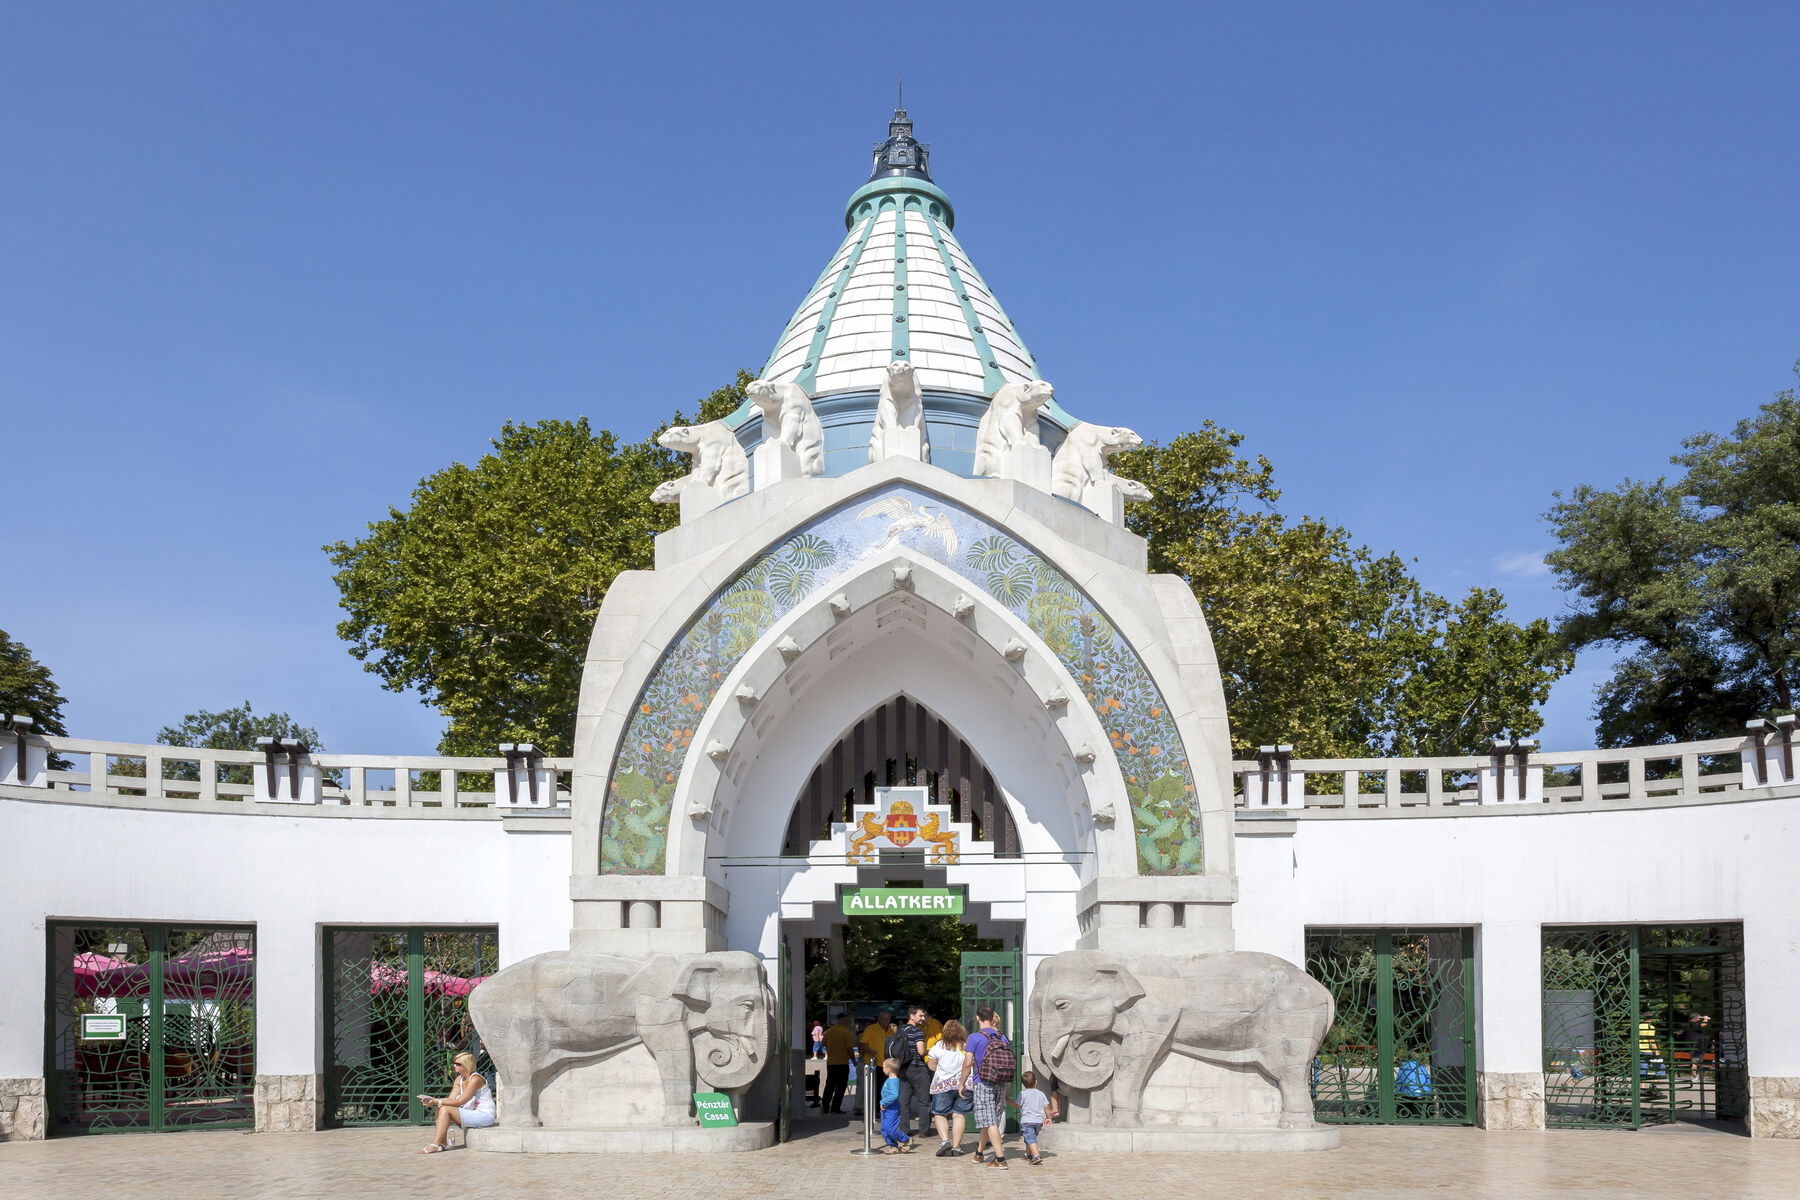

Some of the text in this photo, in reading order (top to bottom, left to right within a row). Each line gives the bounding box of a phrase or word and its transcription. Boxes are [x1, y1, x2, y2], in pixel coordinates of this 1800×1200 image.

[850, 892, 955, 909] ÁLLATKERT
[697, 1100, 730, 1109] Pénztár
[704, 1112, 729, 1120] Cassa
